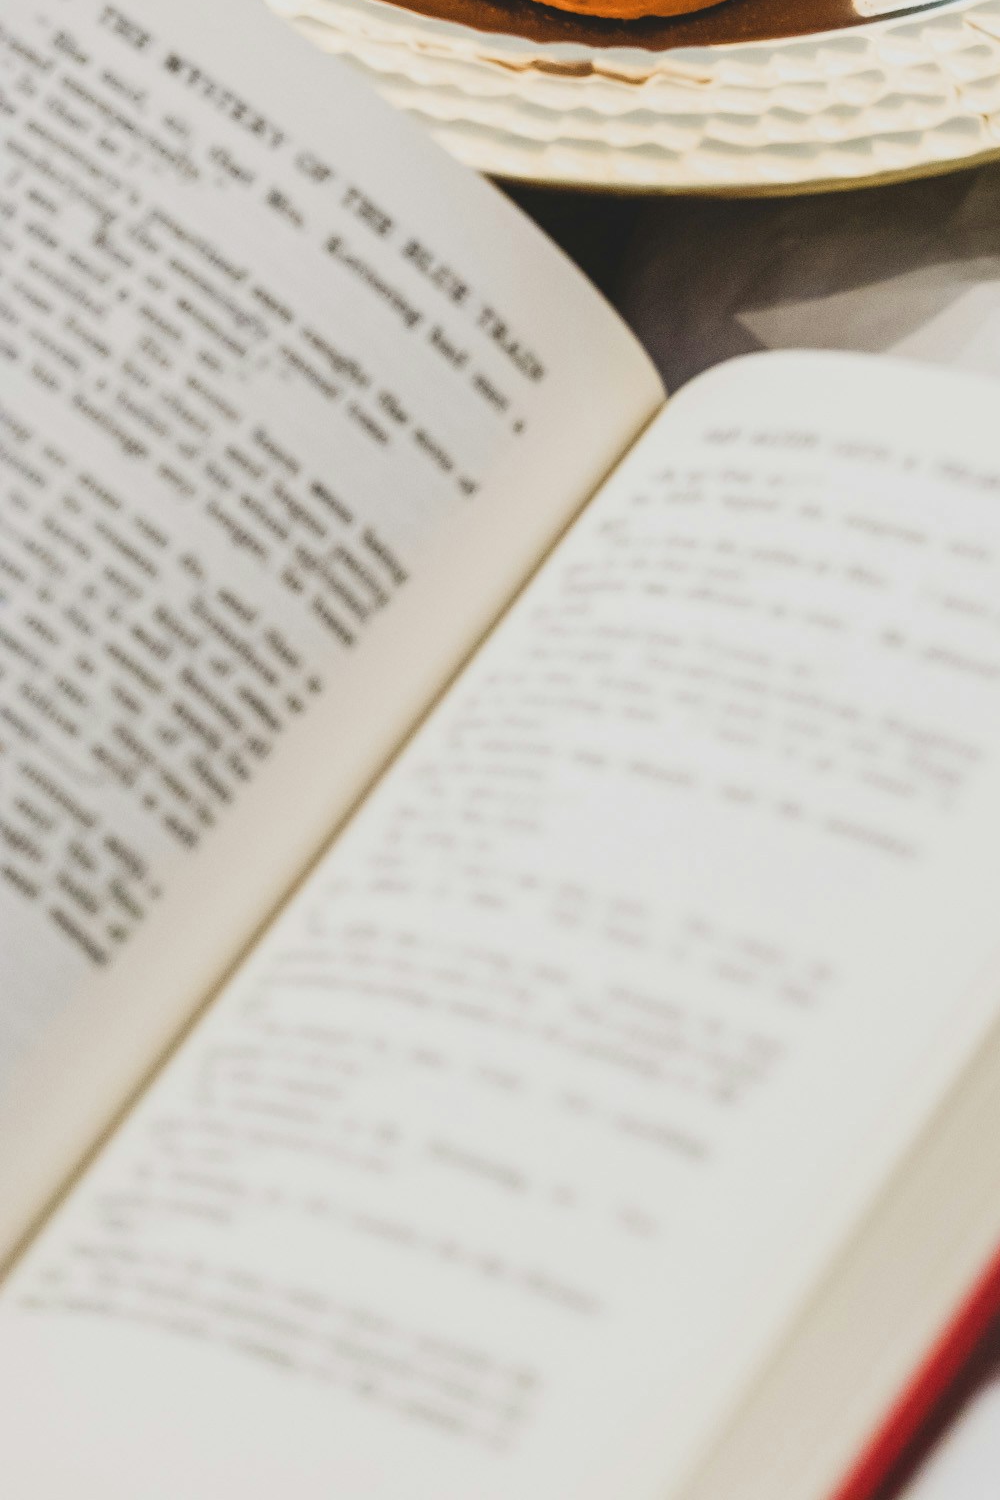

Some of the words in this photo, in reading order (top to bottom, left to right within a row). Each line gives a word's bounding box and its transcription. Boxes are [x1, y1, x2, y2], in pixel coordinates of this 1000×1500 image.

[101, 5, 152, 51] THE
[165, 51, 287, 149] MYSTERY
[296, 150, 332, 182] OF
[341, 185, 396, 238] THE
[476, 304, 547, 383] TRAIN
